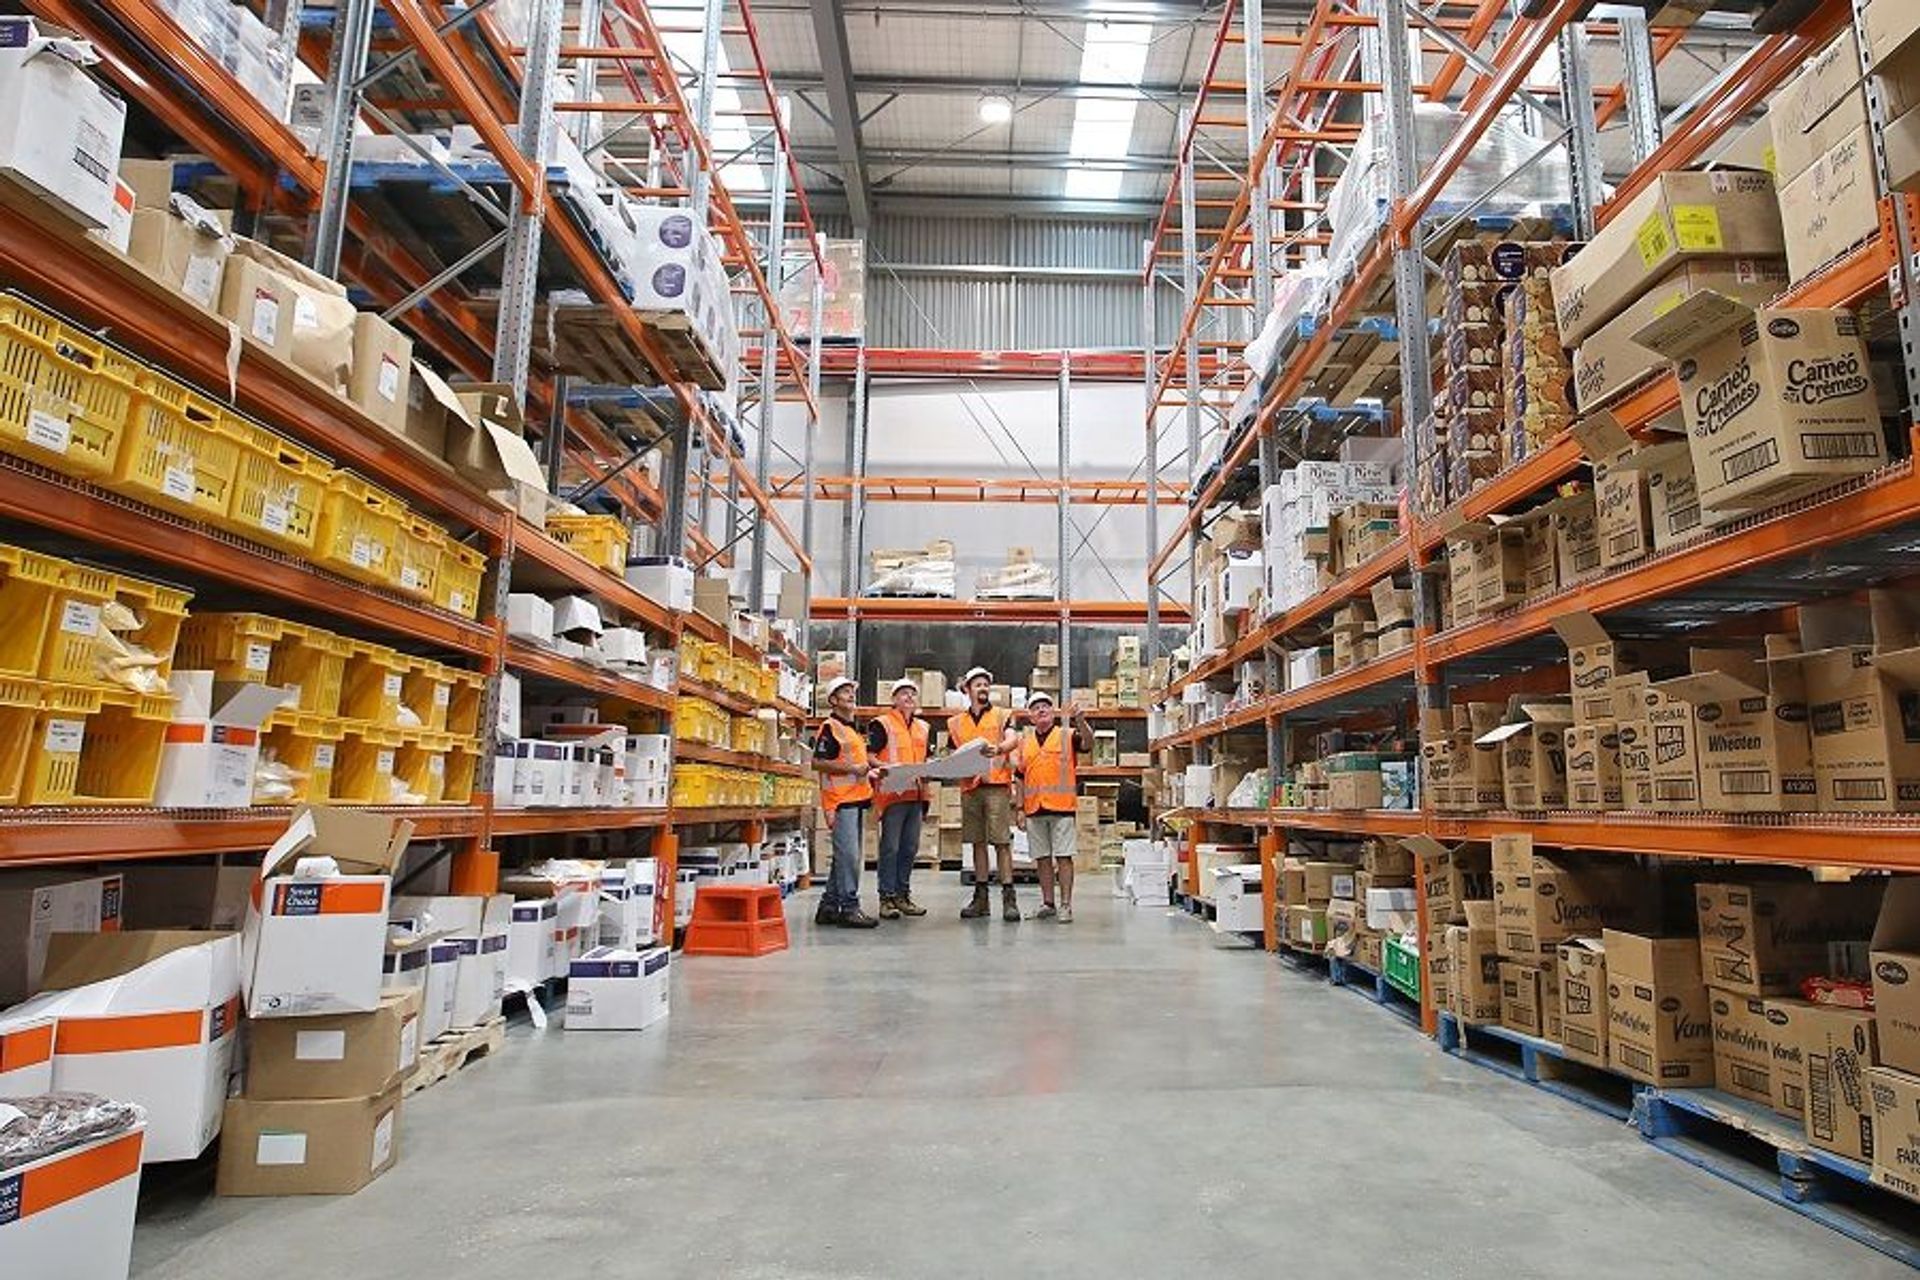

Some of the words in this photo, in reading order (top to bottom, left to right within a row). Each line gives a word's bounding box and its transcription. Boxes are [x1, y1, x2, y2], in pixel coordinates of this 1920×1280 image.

[1708, 734, 1762, 753] Wheaten
[289, 887, 317, 897] Smart
[286, 897, 319, 907] Choice
